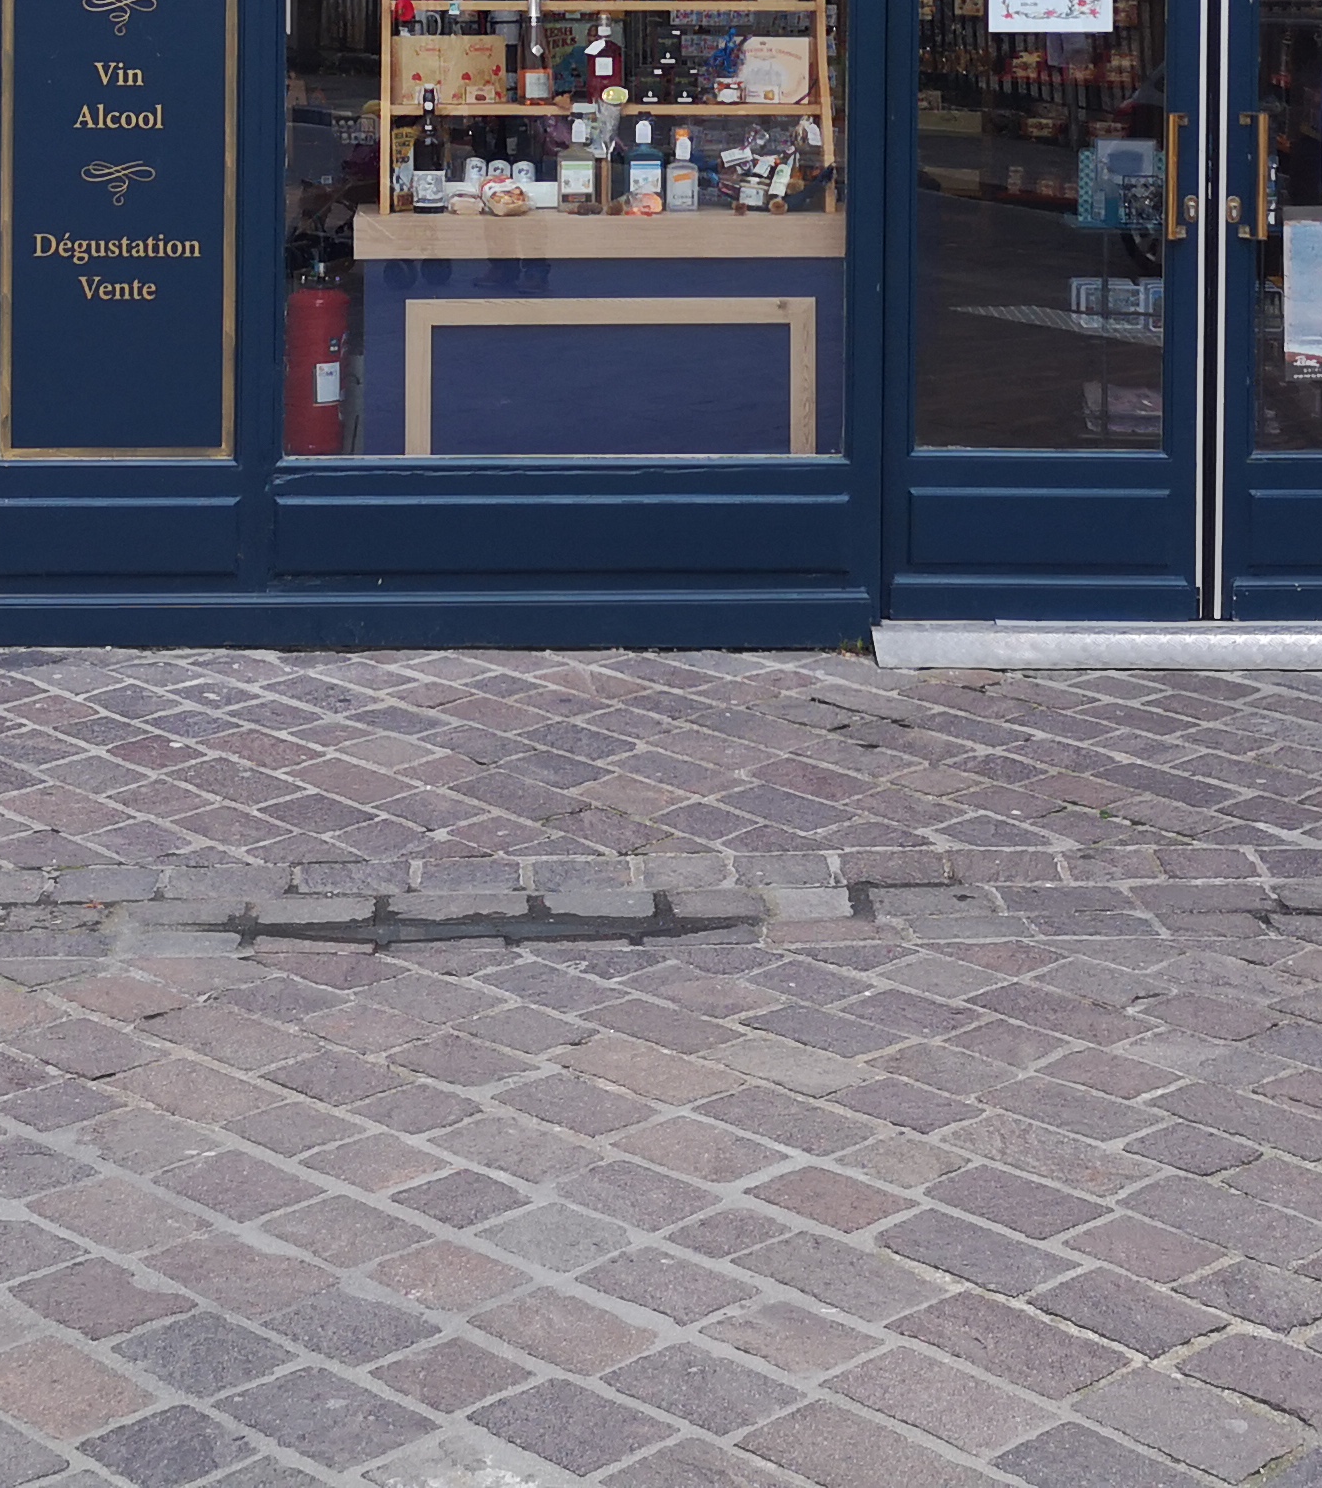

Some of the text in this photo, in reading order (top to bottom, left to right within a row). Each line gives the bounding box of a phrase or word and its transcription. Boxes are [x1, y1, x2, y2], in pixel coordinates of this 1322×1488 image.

[94, 62, 144, 87] Vin
[73, 104, 164, 130] Alcool
[33, 233, 201, 264] Dégustation
[78, 276, 156, 301] Vente
